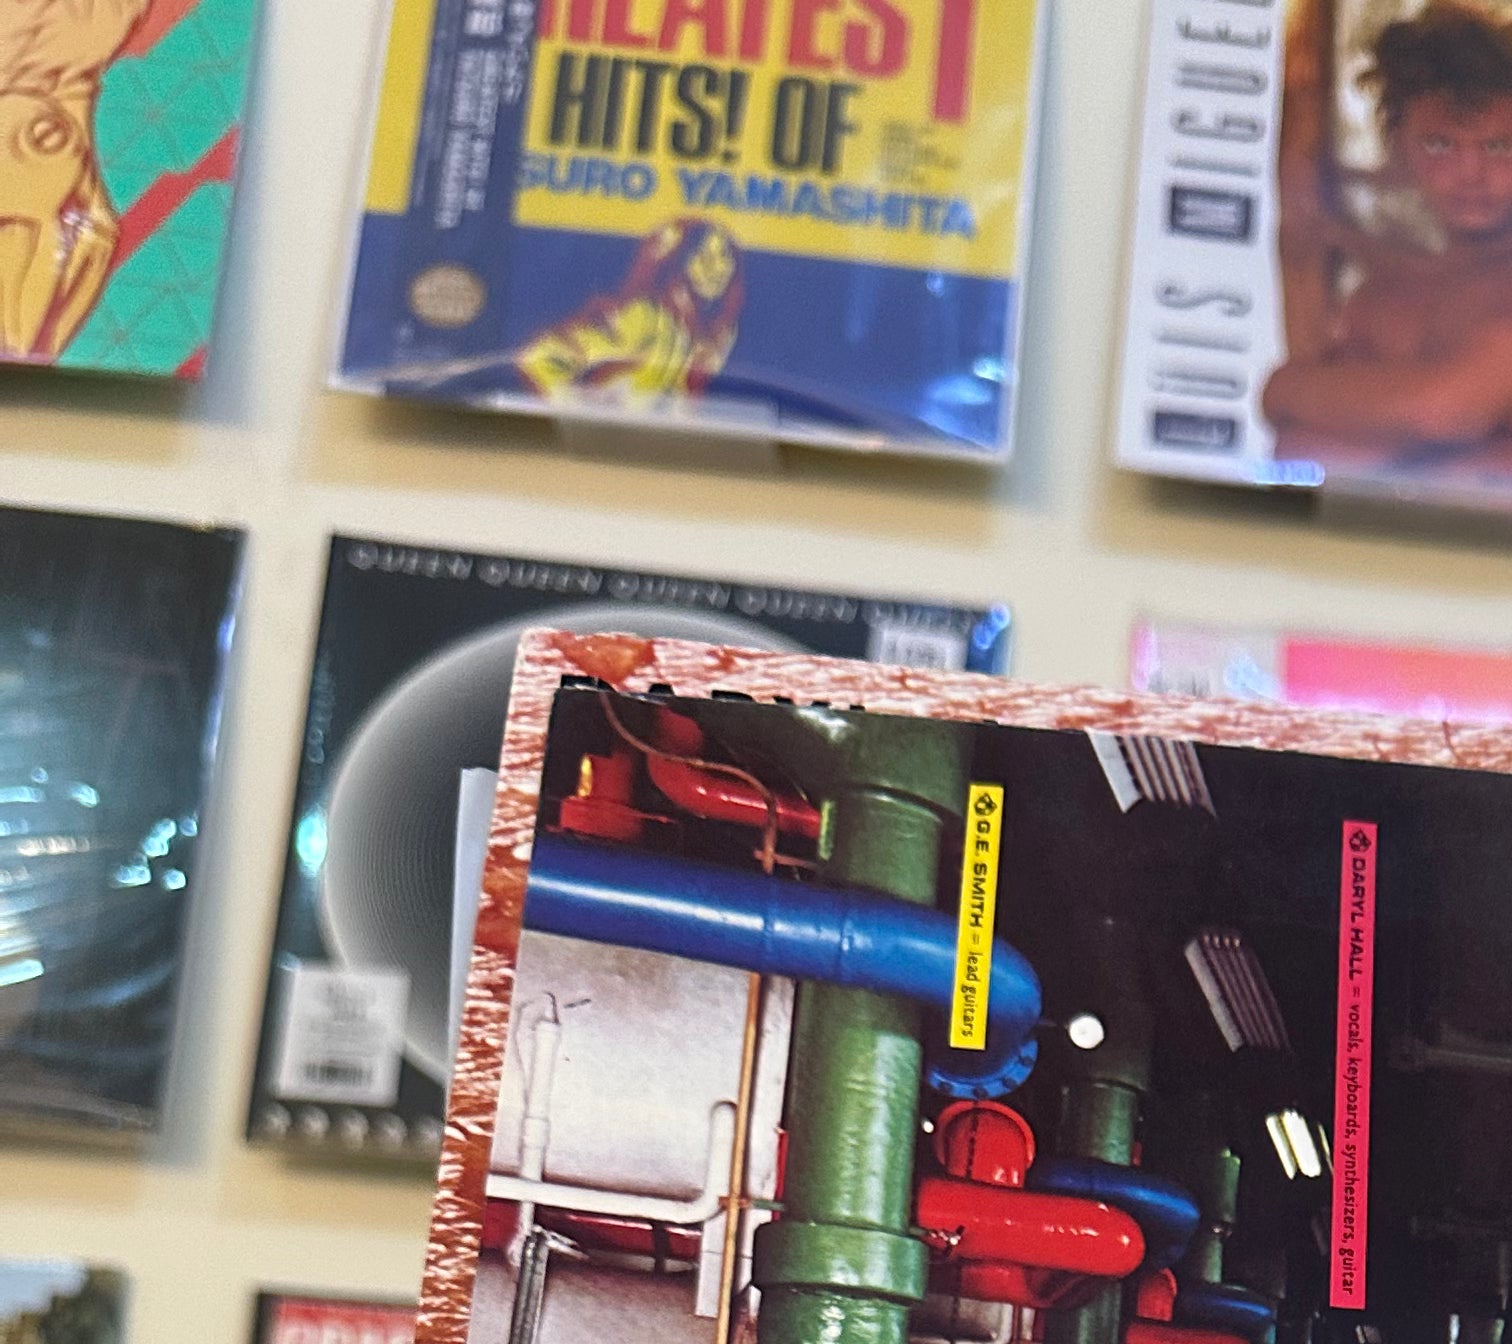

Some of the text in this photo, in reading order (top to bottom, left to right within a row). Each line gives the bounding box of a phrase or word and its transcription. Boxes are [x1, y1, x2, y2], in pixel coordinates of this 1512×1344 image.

[548, 50, 752, 164] HITS!
[771, 72, 861, 176] OF
[674, 163, 976, 241] YAMASHITA
[974, 819, 991, 856] G.E.
[968, 862, 987, 928] SMITH
[1351, 857, 1366, 923] DARYL
[966, 951, 984, 982] lead
[1349, 929, 1364, 980] HALL
[960, 985, 977, 1037] guitars
[1346, 1004, 1364, 1053] vocals,
[1342, 1056, 1363, 1139] keyboards,
[1341, 1144, 1360, 1244] synthesizers,
[1338, 1248, 1355, 1295] guitar
